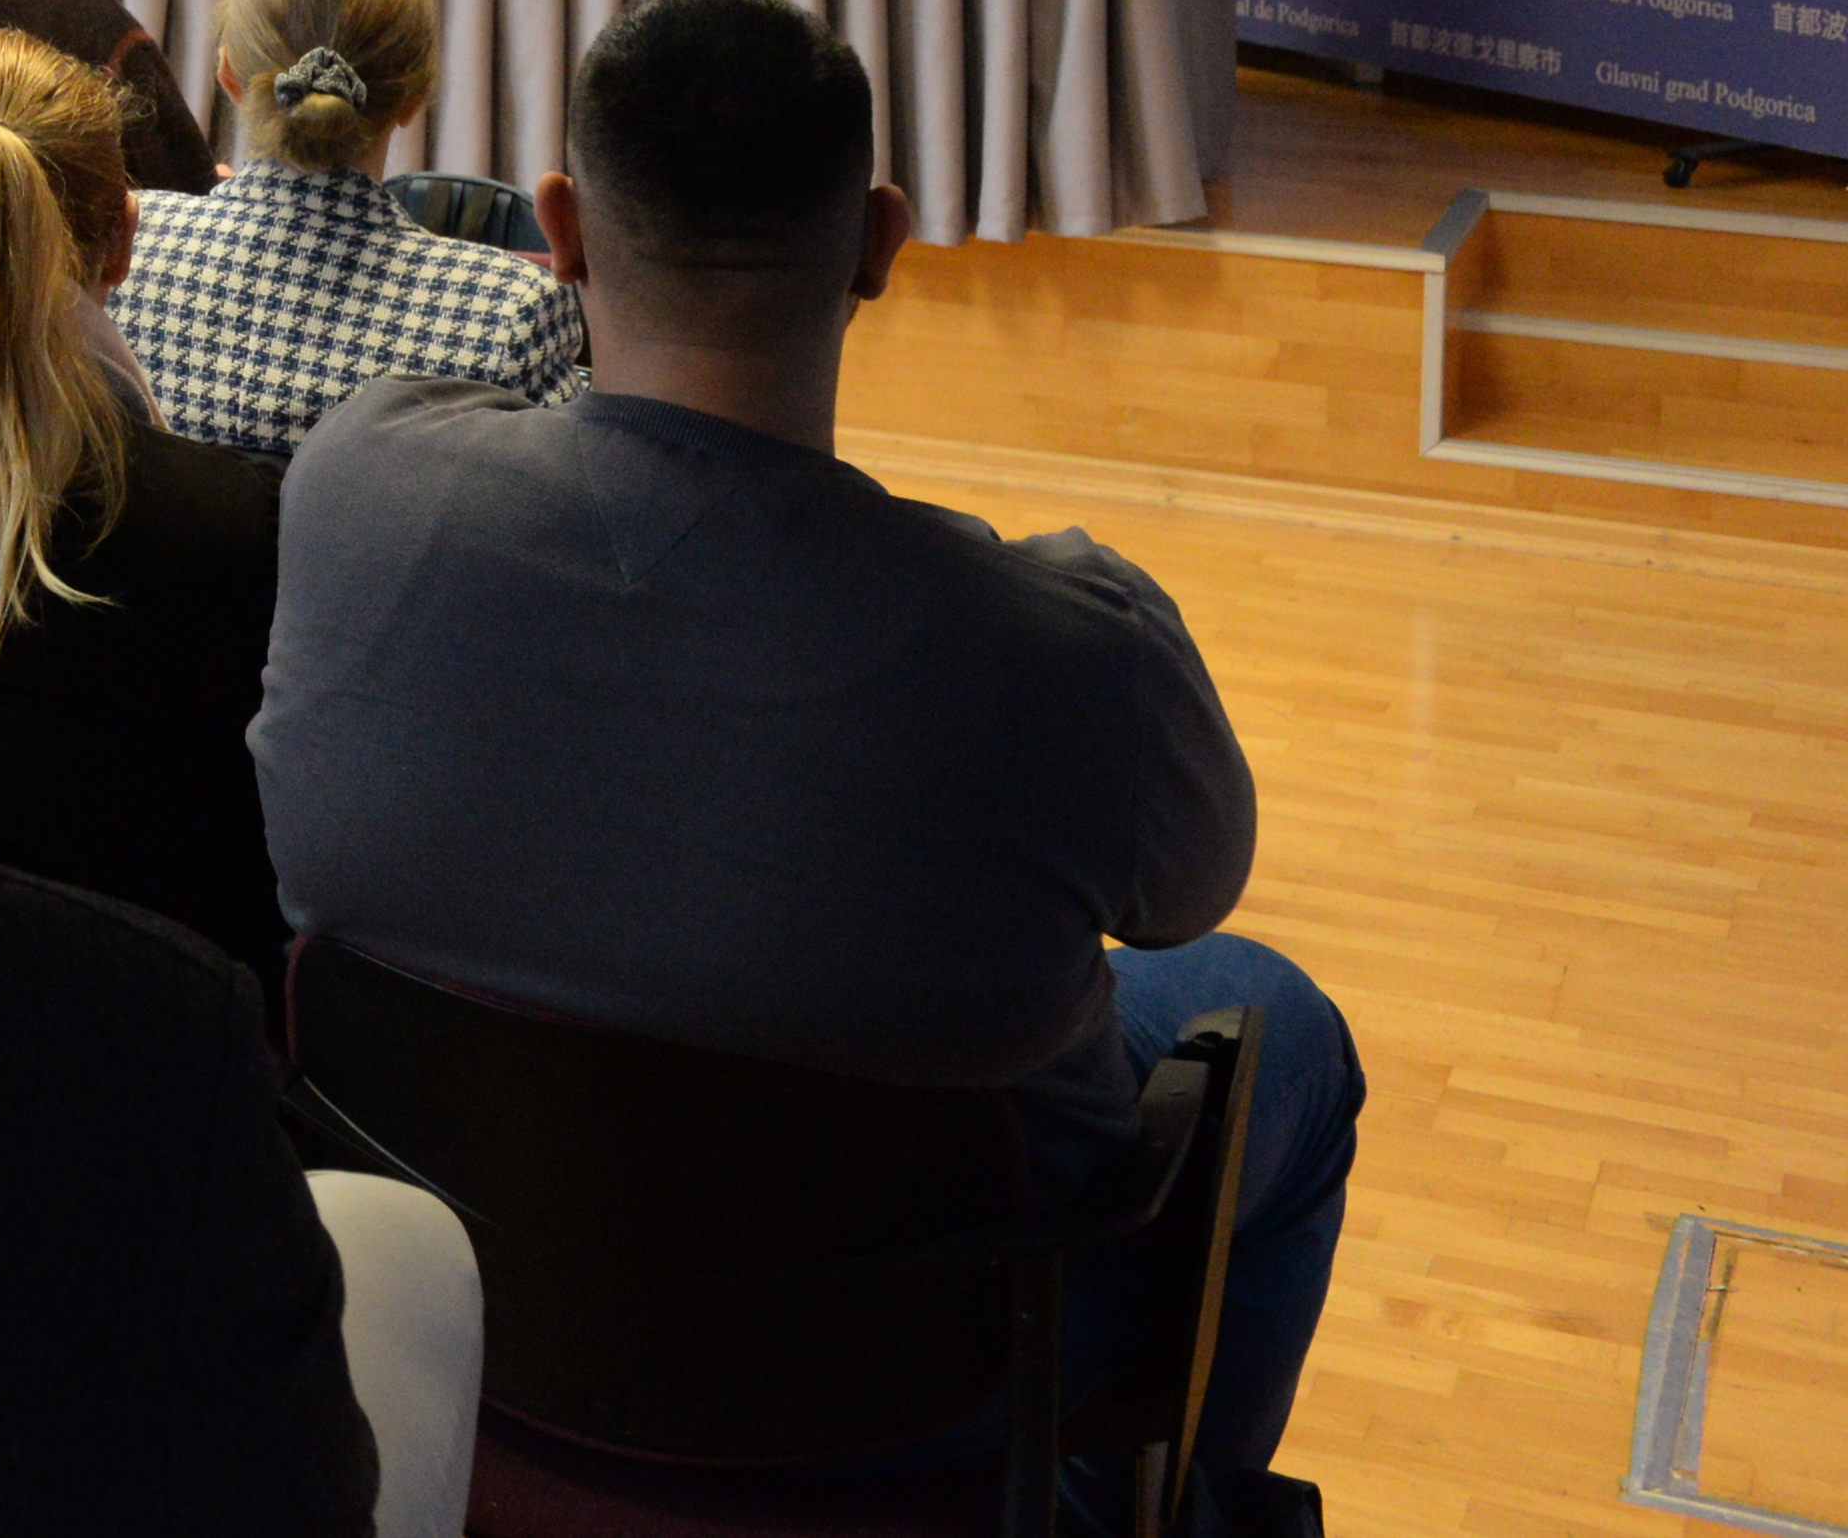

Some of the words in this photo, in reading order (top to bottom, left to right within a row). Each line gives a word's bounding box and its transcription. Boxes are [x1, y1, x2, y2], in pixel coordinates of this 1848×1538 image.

[1595, 61, 1659, 93] Glavni
[1665, 79, 1709, 102] grad
[1715, 82, 1816, 122] Podgorica
